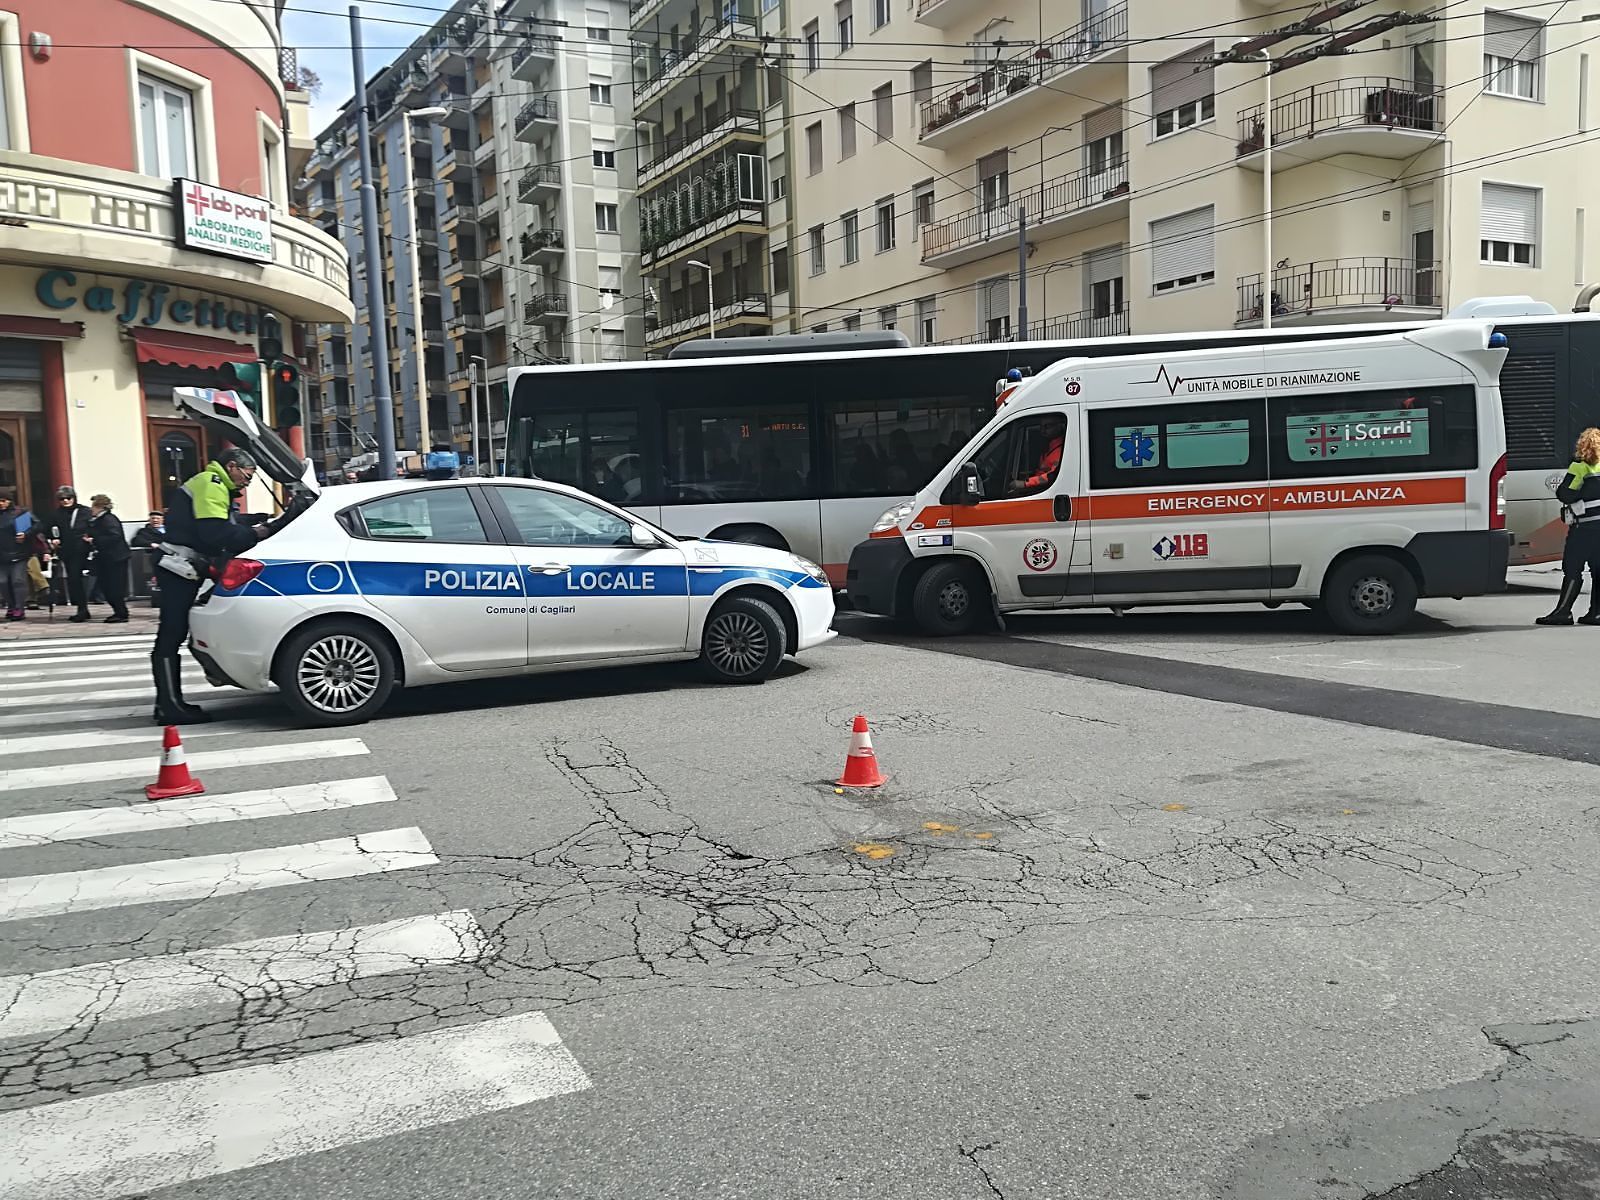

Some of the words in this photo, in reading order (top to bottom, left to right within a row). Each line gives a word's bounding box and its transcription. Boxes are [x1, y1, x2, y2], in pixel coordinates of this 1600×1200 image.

[211, 192, 232, 212] lab
[195, 216, 263, 240] LABORATORIO
[187, 227, 227, 244] ANALISI
[230, 237, 271, 254] MEDICHE
[36, 270, 259, 334] Caffetter
[1068, 385, 1078, 393] 87
[1187, 379, 1220, 393] UNITÀ
[1222, 378, 1263, 390] MOBILE
[1266, 376, 1278, 388] DI
[1281, 371, 1361, 386] RIANIMAZIONE
[1355, 420, 1412, 440] Sardi
[1148, 494, 1266, 511] EMERGENCY
[1283, 487, 1406, 505] AMBULANZA
[1173, 534, 1208, 556] 118
[425, 570, 520, 590] POLIZIA
[566, 571, 655, 590] LOCALE
[486, 606, 526, 614] Comune
[540, 605, 576, 615] Cagliari
